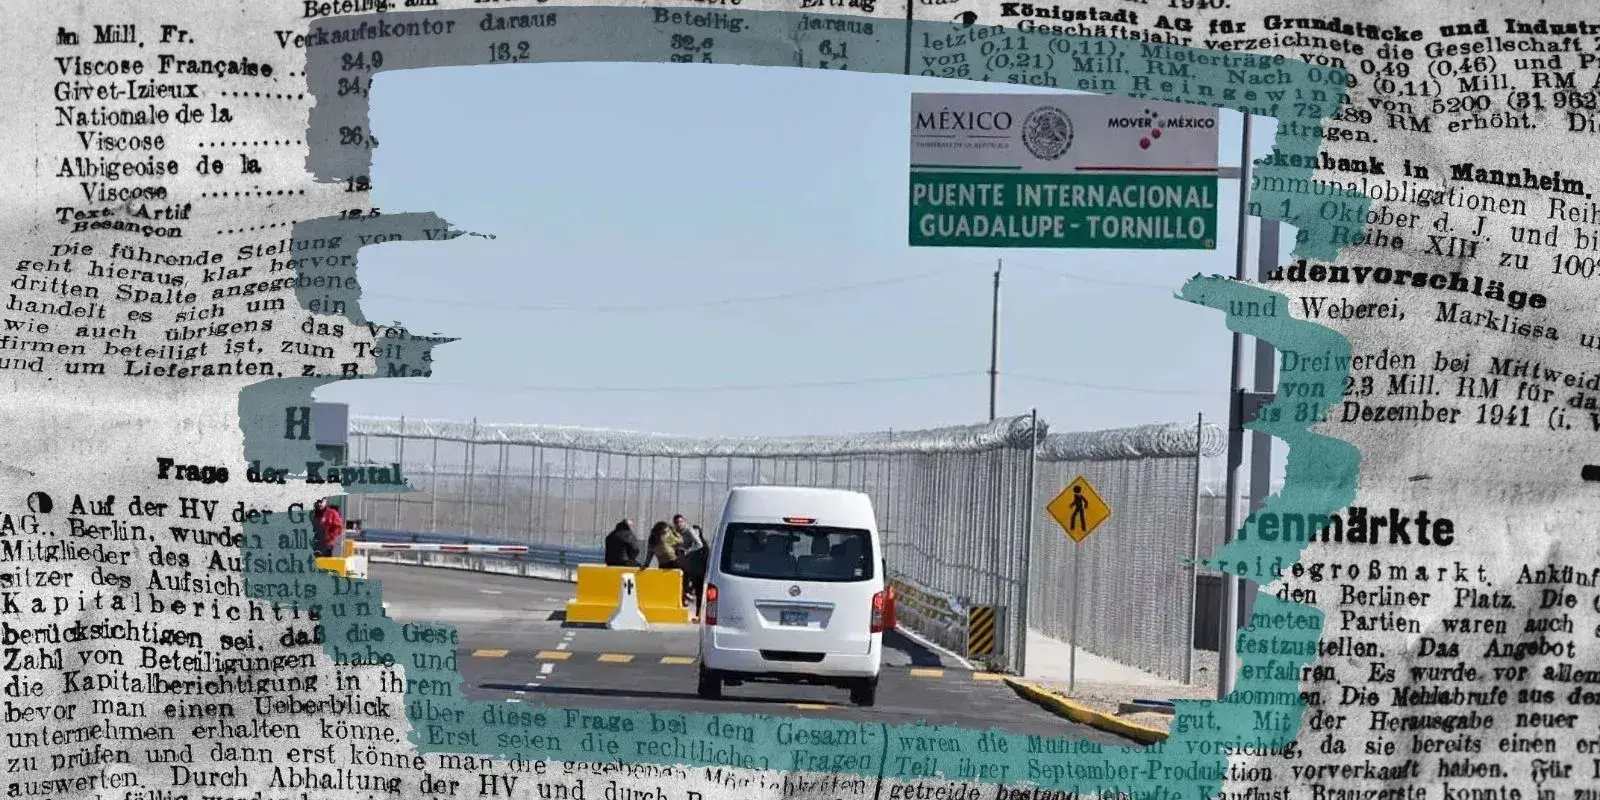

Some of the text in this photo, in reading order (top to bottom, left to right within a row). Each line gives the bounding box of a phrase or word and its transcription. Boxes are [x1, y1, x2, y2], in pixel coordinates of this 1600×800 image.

[160, 18, 456, 49] Fr. Verkaufskontor
[480, 12, 557, 32] daraus
[652, 7, 749, 33] Beteilig.
[1000, 1, 1489, 42] Königstadt AG für Grundstücke und
[923, 19, 1582, 58] letzten Geschäftsjahr verzeichnete Gesellschaft
[54, 56, 144, 76] Viscose
[922, 51, 966, 67] von
[986, 53, 1053, 72] (0,21)
[1227, 69, 1292, 85] Nach
[1373, 78, 1441, 97] (0,11)
[1532, 71, 1576, 89] RM
[1140, 43, 1562, 78] Mieterträge von 0,49 (0,46) und
[54, 79, 198, 102] Givet-Izieux
[1077, 76, 1491, 114] ein von 5200
[55, 104, 169, 126] Nationale
[916, 107, 1012, 132] MÉXICO
[1108, 114, 1215, 129] MOVER MÉXICO
[1387, 111, 1537, 133] RM erhöht.
[77, 131, 165, 151] Viscose
[56, 153, 262, 180] Albigeoise de la
[80, 182, 168, 201] Viscose
[1450, 162, 1592, 200] Mannheim.
[913, 183, 1214, 209] PUENTE INTERNACIONAL
[70, 219, 182, 238] Besançon
[920, 214, 1065, 238] GUADALUPE
[1086, 216, 1205, 239] TORNILLO
[1320, 200, 1559, 247] Oktober und
[110, 235, 342, 266] führende Stellung
[1331, 225, 1529, 270] Reihe zu
[16, 258, 252, 284] geht klar
[11, 275, 197, 304] dritten Spalte
[6, 294, 346, 323] handelt es sich um ein
[1230, 296, 1559, 341] und Weberei, Marklissa
[4, 317, 344, 341] wie auch übrigens das
[103, 340, 402, 361] beteiligt zum Teil
[1281, 348, 1471, 372] Dreiwerden bei
[64, 361, 106, 375] um
[1281, 374, 1500, 398] von Mill. RM
[1341, 400, 1530, 427] Dezember 1941
[157, 457, 290, 484] Frage der
[129, 496, 273, 524] der HV der
[169, 526, 261, 550] wurden
[1, 540, 190, 567] Mitglieder des
[0, 566, 317, 599] sitzer des Aufsichtsrats
[1276, 583, 1578, 610] den Berliner Die
[1, 618, 386, 648] berücksichtigen die
[1340, 610, 1574, 634] Partien waren auch
[78, 645, 457, 674] von Beteiligungen habe und
[1236, 633, 1576, 660] festzustellen. Das Angebot
[4, 669, 453, 697] die Kapitalberichtigung in ihrem
[1367, 661, 1528, 683] Es wurde vor
[1339, 685, 1555, 707] Die aus
[4, 694, 876, 746] bevor man einen Ueberblick über diese Frage bei dem Gesamt-
[1253, 709, 1579, 733] Mit der Herausgabe neuer
[6, 718, 619, 755] unternehmen erhalten könne. Erst seien die
[899, 732, 1556, 759] waren die vorsichtig, da sie bereits einen
[8, 743, 493, 773] zu prüfen und dann erst könne man
[896, 756, 1508, 787] Teil ihrer September-Produktion vorverkauft haben.
[7, 765, 518, 798] auswerten. Durch Abhaltung der HV
